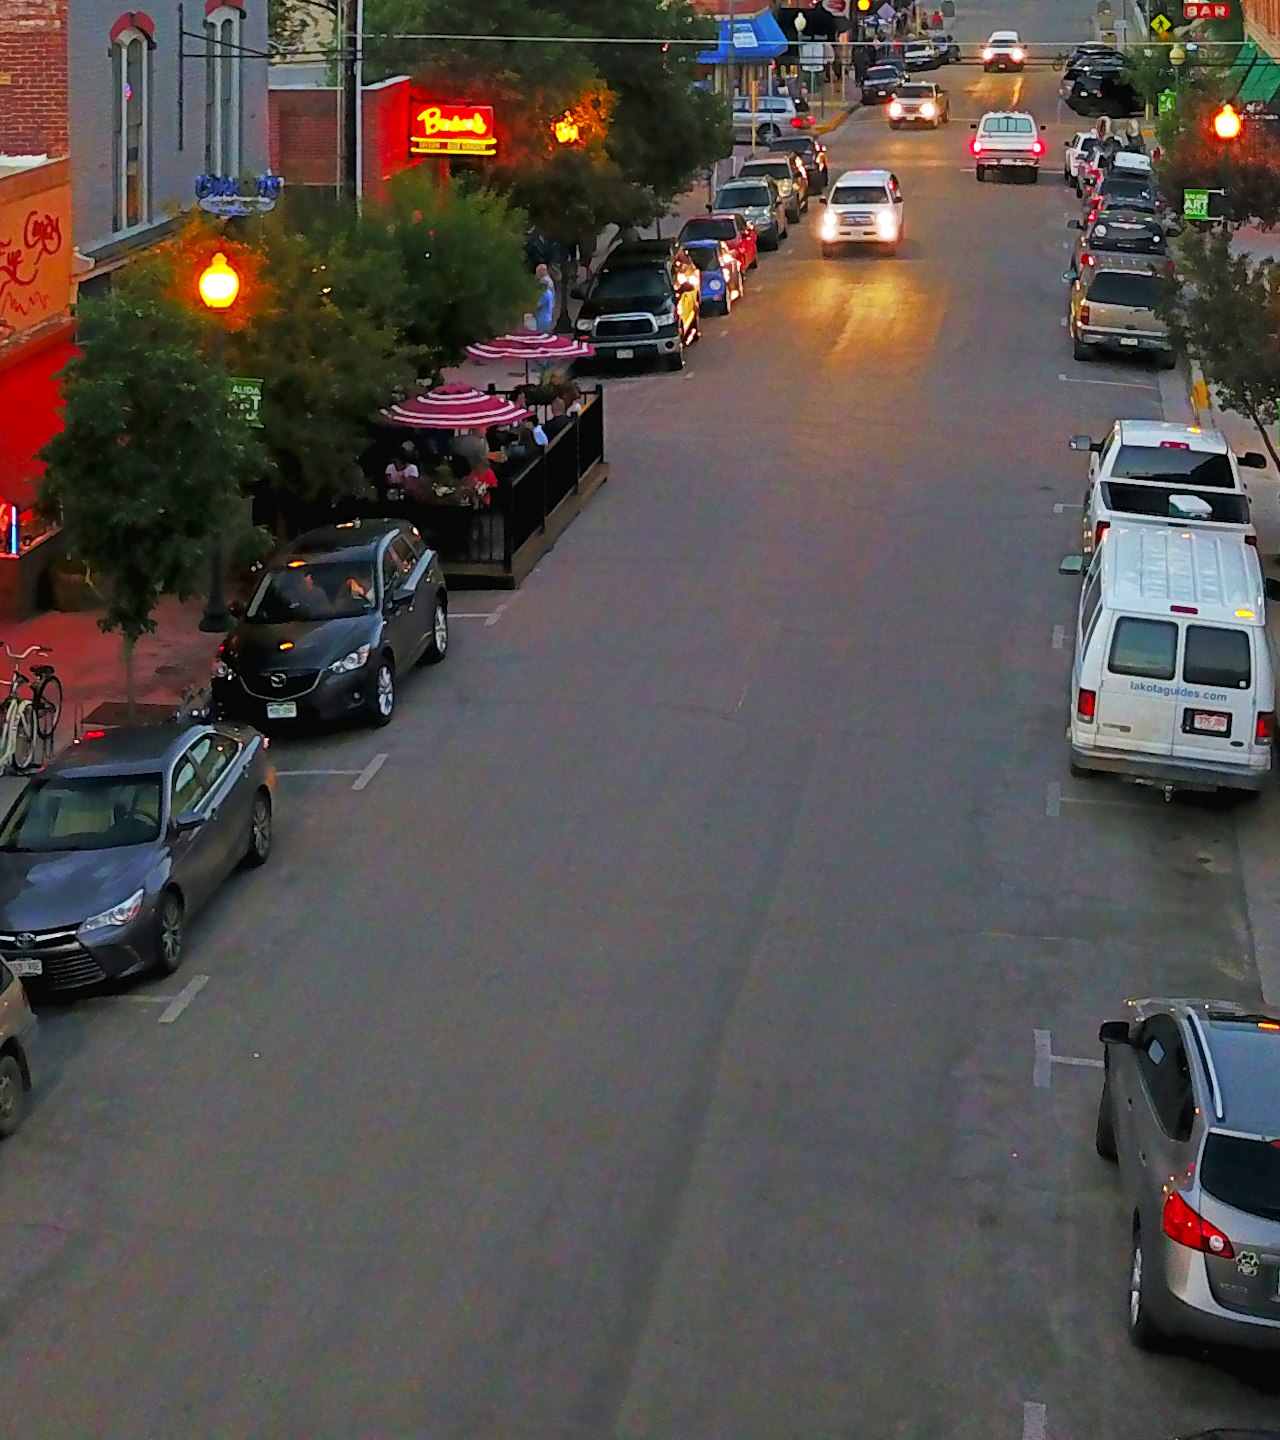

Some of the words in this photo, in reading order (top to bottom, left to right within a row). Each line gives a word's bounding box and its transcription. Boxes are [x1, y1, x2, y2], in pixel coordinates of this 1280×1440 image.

[1186, 5, 1226, 17] BAR
[1183, 200, 1209, 209] ART
[232, 385, 261, 395] ALIDA
[1130, 681, 1227, 701] lakotaguides.com
